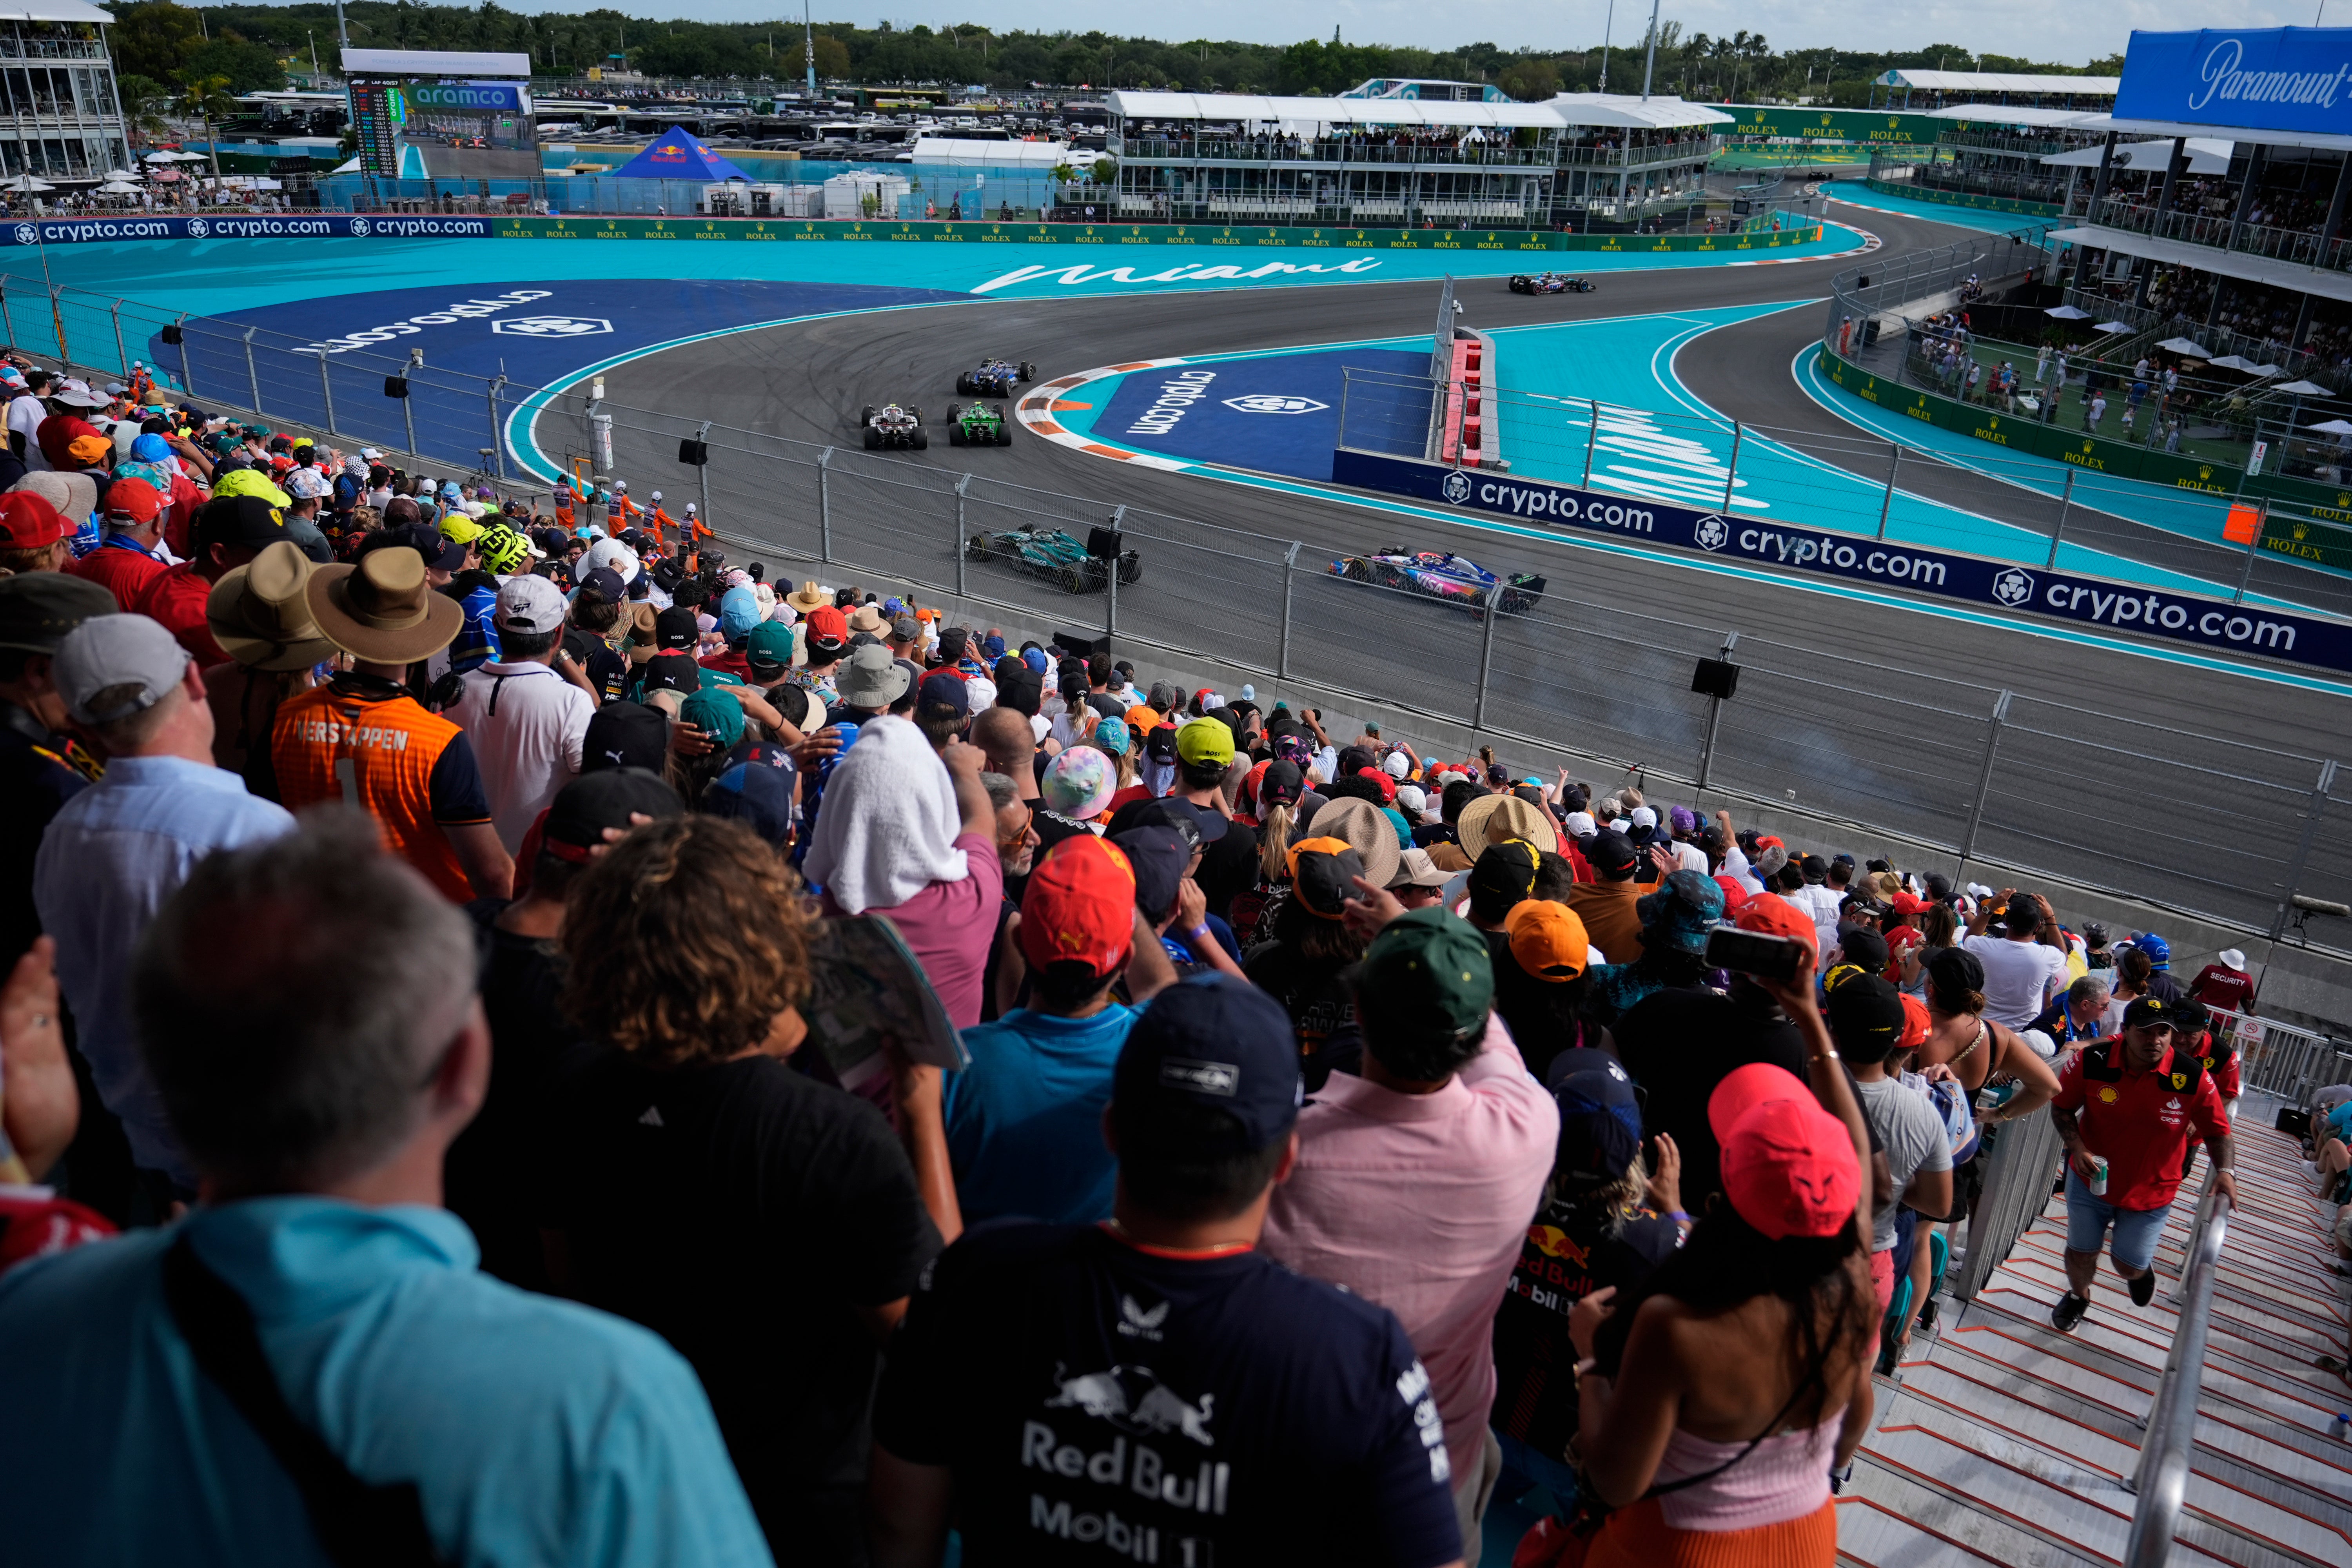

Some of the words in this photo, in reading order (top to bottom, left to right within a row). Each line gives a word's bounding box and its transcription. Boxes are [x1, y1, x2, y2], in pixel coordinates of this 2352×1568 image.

[2189, 39, 2352, 110] Paramount
[417, 89, 505, 105] aramco
[1738, 125, 1778, 134] ROLEX
[1803, 128, 1844, 138] ROLEX
[1870, 131, 1912, 141] ROLEX
[45, 222, 169, 241] crypto.com
[216, 219, 331, 237] crypto.com
[376, 219, 485, 236] crypto.com
[1126, 371, 1217, 434] crypto.com
[1861, 388, 1877, 401] ROLEX
[1908, 406, 1931, 421] ROLEX
[1975, 427, 2007, 444] ROLEX
[2064, 452, 2104, 470] ROLEX
[2177, 477, 2227, 498] ROLEX
[1480, 480, 1653, 533] crypto.com
[2312, 507, 2352, 523] ROLE
[1739, 529, 1947, 586] crypto.com
[2267, 537, 2323, 561] ROLEX
[1416, 572, 1444, 595] VISA
[2046, 583, 2296, 652] crypto.com
[607, 681, 623, 689] Claro
[608, 672, 624, 681] Mobil
[297, 720, 409, 751] VERSTAPPEN
[2210, 972, 2246, 987] SECURITY
[2160, 1108, 2184, 1116] Santander
[1546, 1262, 1594, 1298] Bull
[1022, 1419, 1127, 1486] Red
[1131, 1443, 1230, 1515] Bull
[1030, 1494, 1160, 1565] Mobil
